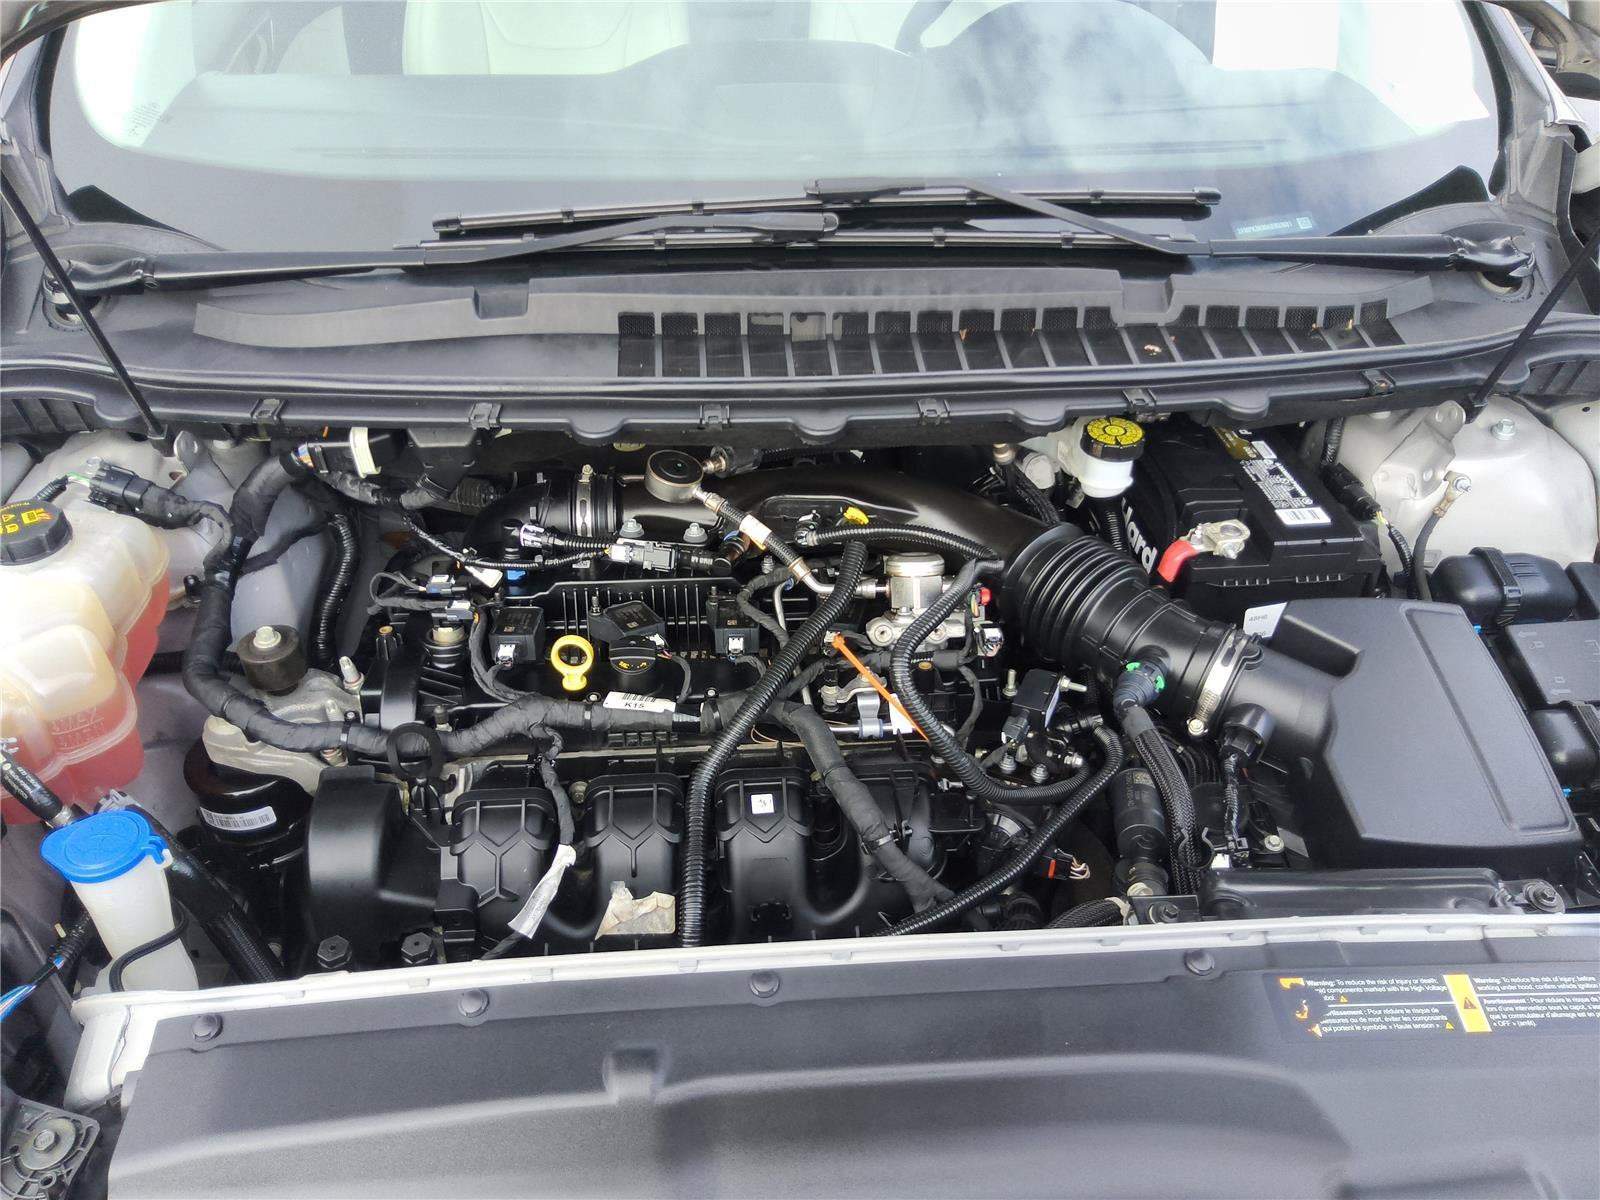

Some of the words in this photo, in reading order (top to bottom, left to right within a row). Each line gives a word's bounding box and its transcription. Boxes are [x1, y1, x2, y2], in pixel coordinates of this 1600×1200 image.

[1305, 979, 1336, 987] Warning:
[1426, 984, 1448, 992] Voltage
[1362, 1024, 1388, 1032] symbole
